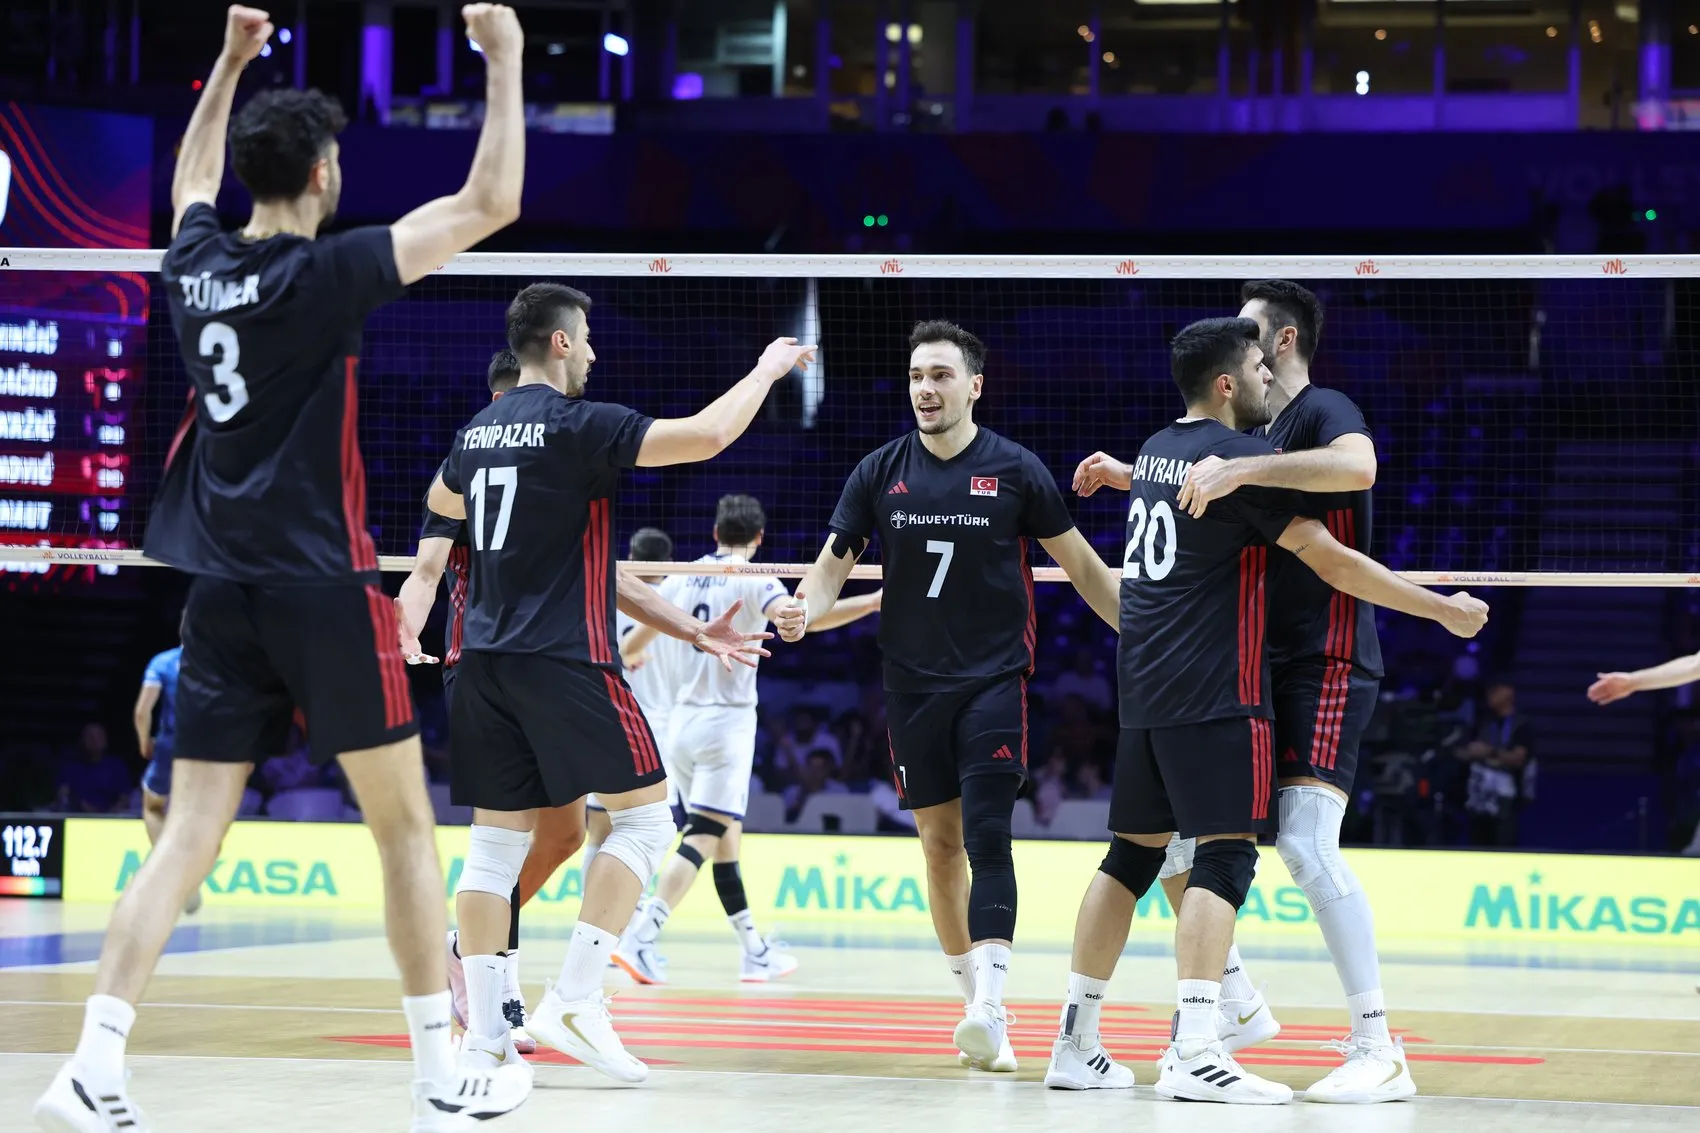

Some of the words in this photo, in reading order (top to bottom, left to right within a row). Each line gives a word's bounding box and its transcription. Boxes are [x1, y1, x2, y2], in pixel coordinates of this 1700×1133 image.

[649, 257, 672, 273] VNL
[880, 258, 904, 274] VNL
[1115, 259, 1140, 275] VNL
[1355, 259, 1380, 276] VNL
[1602, 258, 1627, 274] VNL
[199, 321, 249, 422] 3
[470, 466, 518, 551] 17
[1121, 497, 1177, 580] 20
[57, 551, 110, 560] VOLLEYBALL
[926, 540, 955, 598] 7
[2, 825, 53, 858] 112.7
